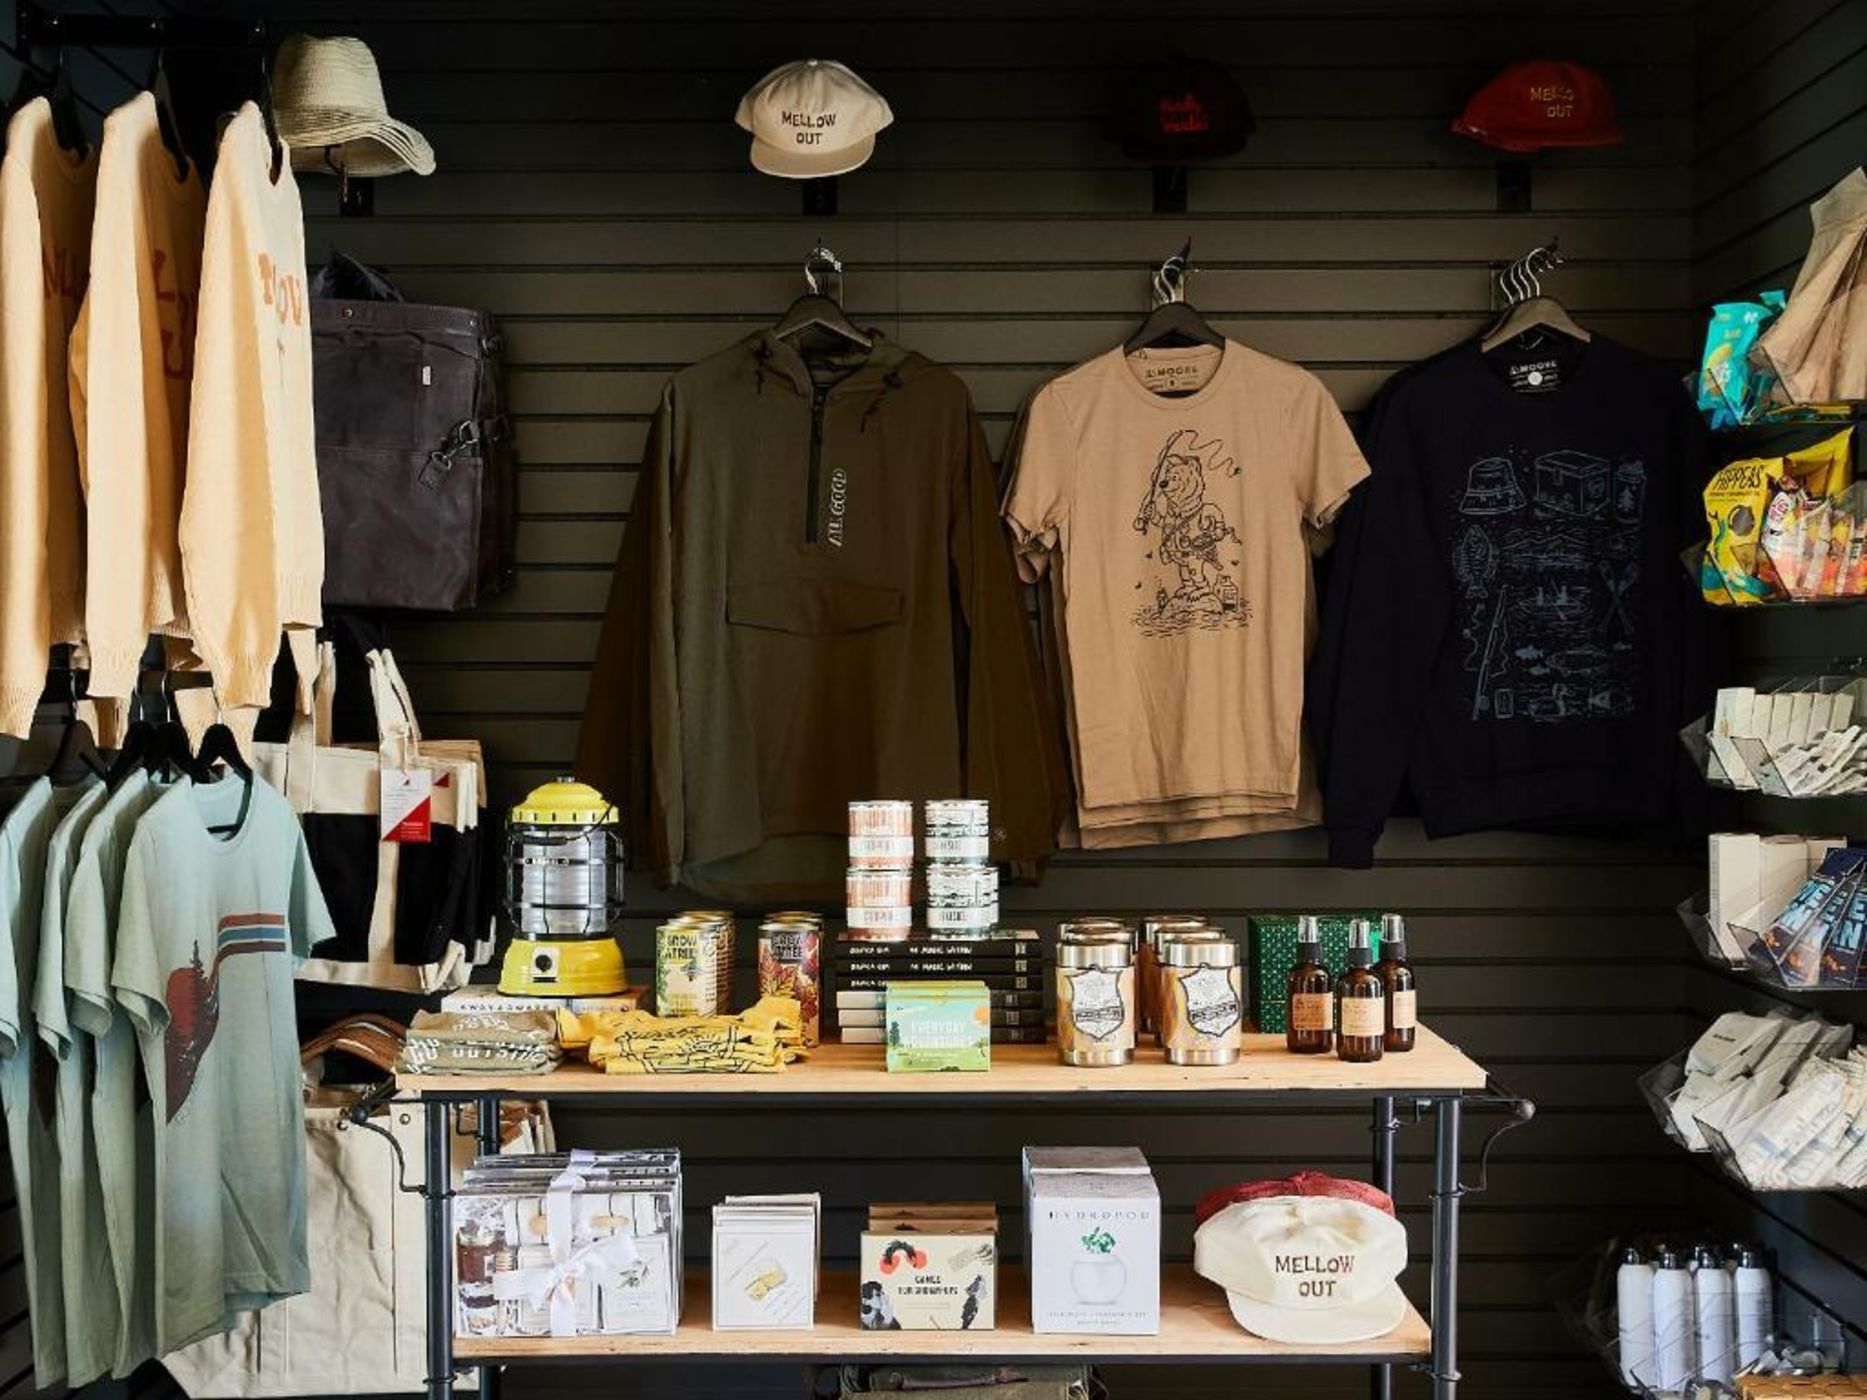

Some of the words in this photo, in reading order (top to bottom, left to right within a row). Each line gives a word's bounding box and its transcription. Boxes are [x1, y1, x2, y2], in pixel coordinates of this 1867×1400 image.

[1547, 104, 1573, 118] OUT
[781, 110, 836, 129] MELLOW
[796, 132, 823, 145] OUT
[1275, 1255, 1355, 1273] MELLOW
[1299, 1281, 1337, 1297] OUT
